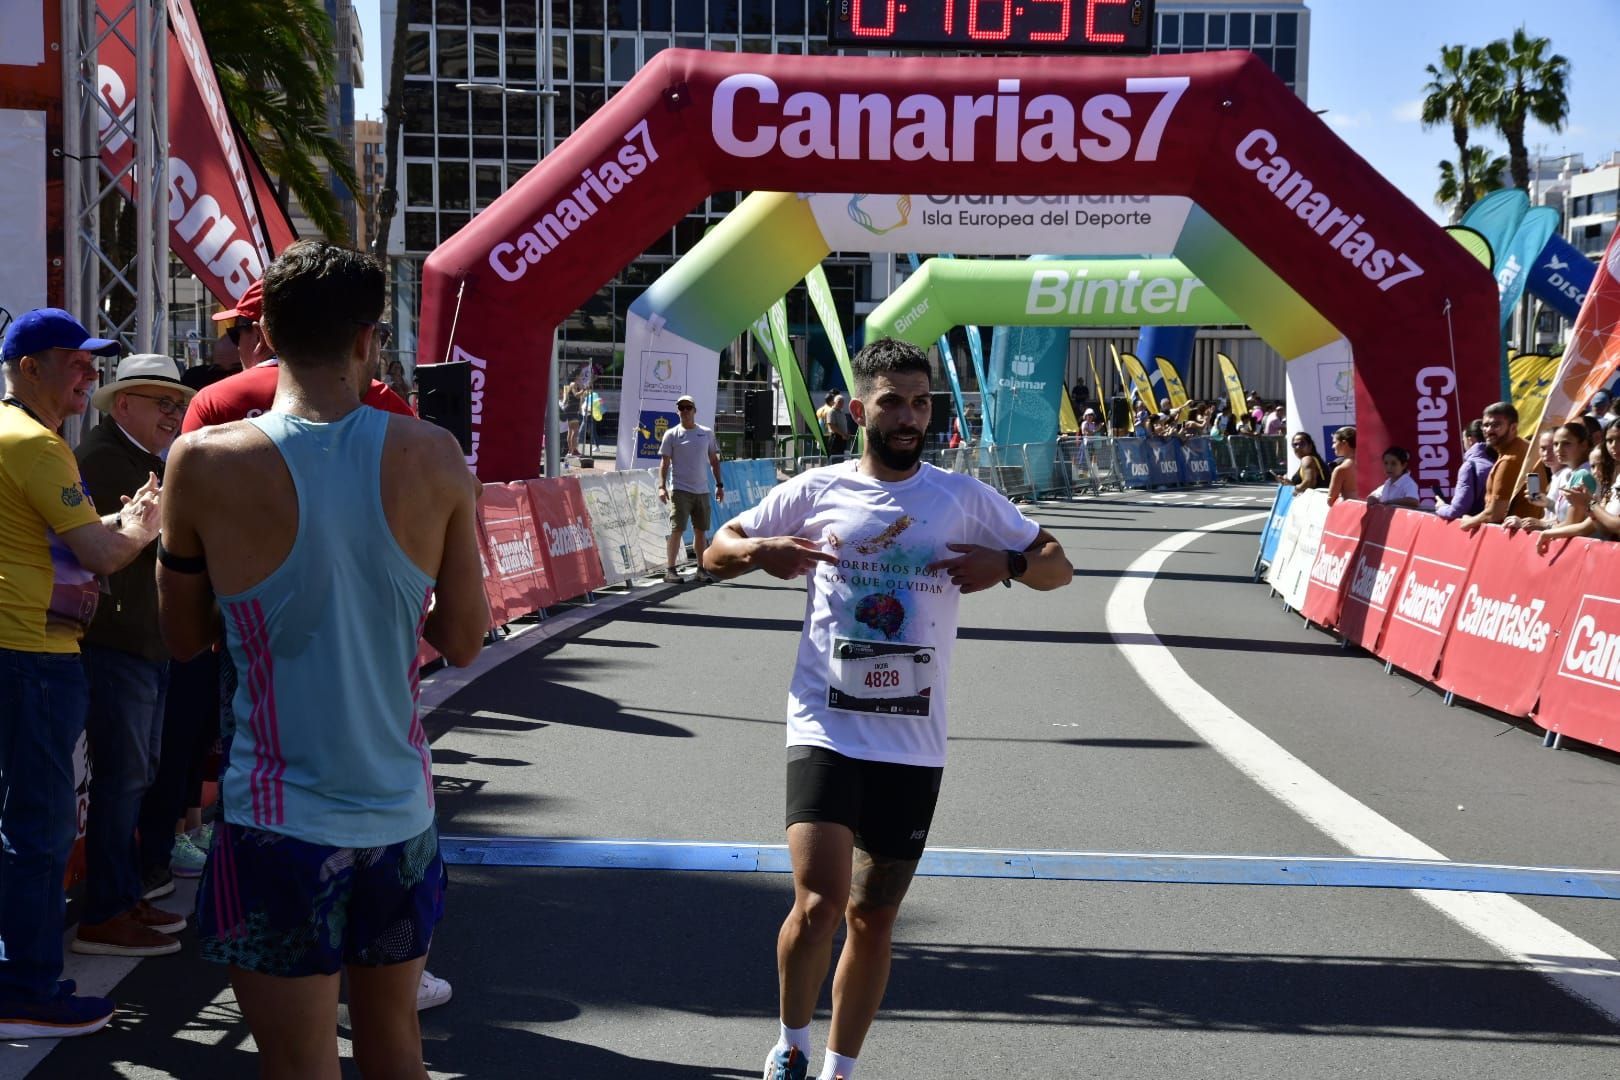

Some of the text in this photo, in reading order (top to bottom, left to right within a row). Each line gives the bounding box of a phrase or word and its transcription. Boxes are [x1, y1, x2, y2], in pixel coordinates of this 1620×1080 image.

[711, 73, 1191, 162] Canarias7
[488, 118, 660, 282] Canarias7
[922, 210, 1152, 228] Isla Europea del Deporte
[1235, 129, 1424, 292] Canarias7
[1025, 269, 1206, 315] Binter
[894, 298, 930, 334] Binter
[998, 376, 1046, 390] cajamar
[851, 575, 880, 587] QUE
[886, 579, 944, 594] OLVIDAN
[1398, 571, 1456, 627] Canarias7
[864, 670, 900, 688] 4828
